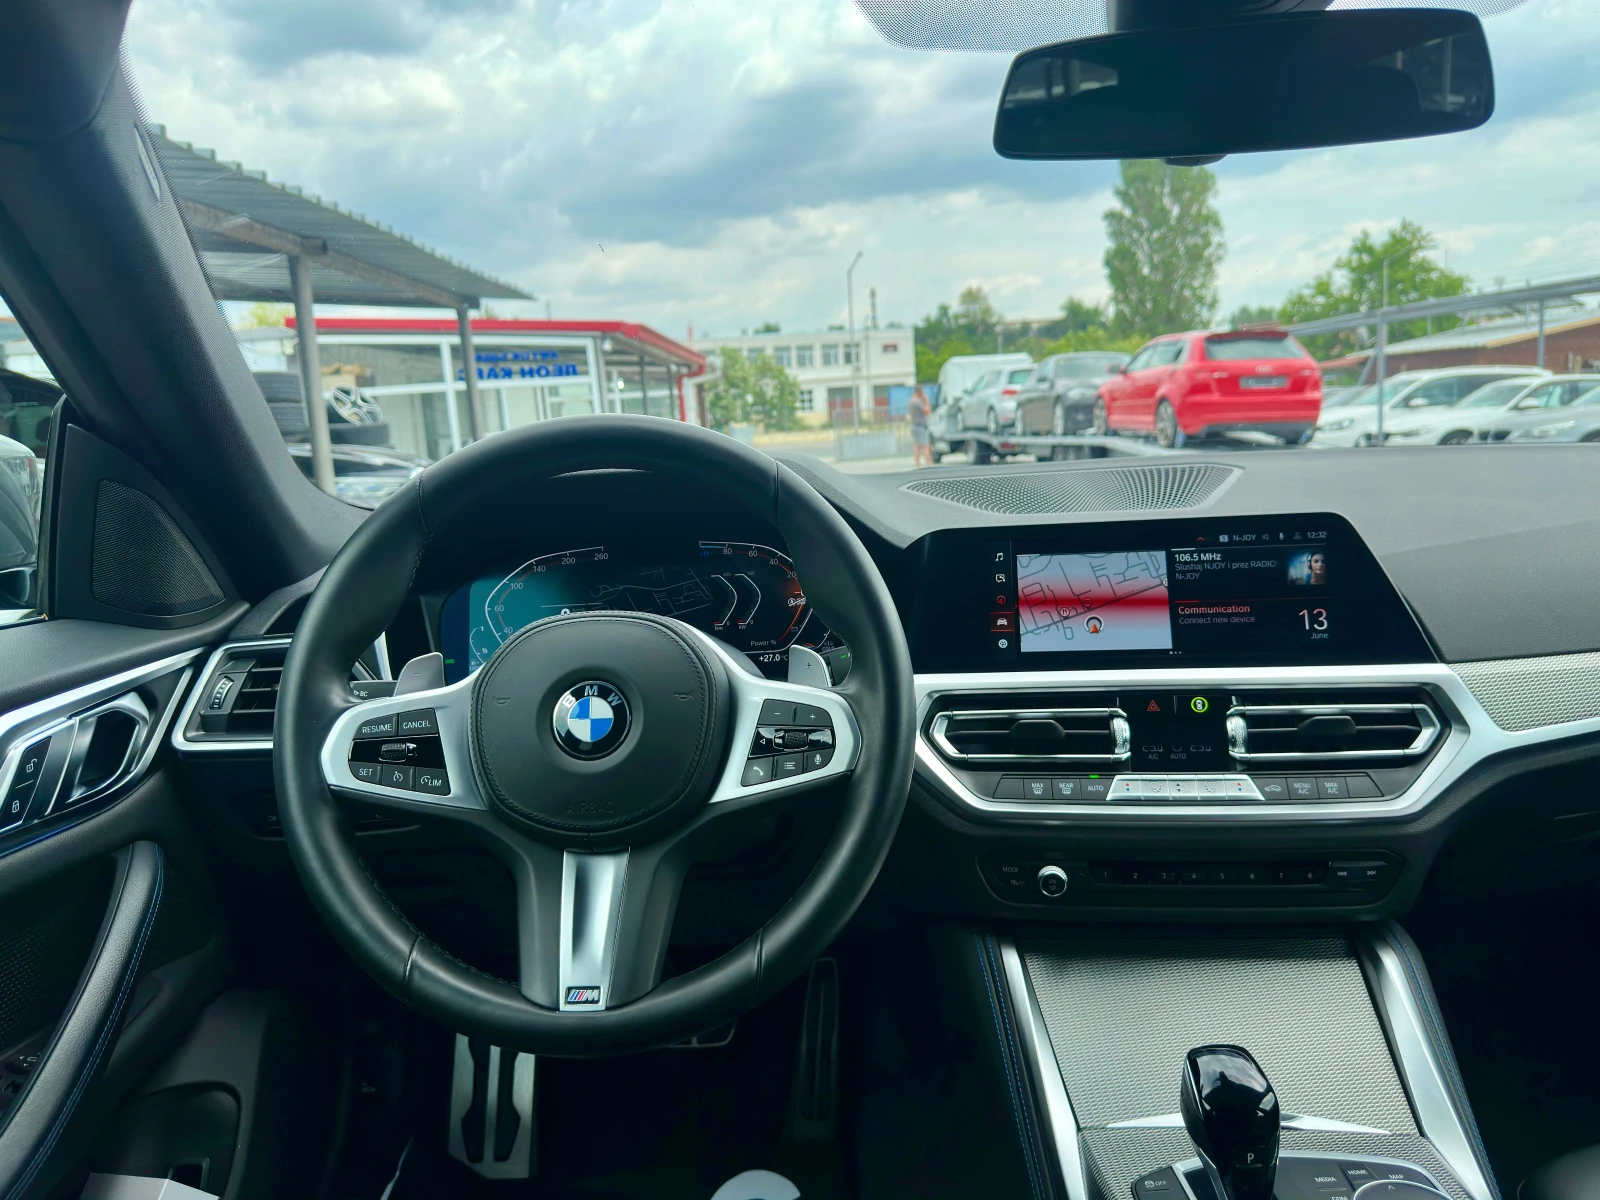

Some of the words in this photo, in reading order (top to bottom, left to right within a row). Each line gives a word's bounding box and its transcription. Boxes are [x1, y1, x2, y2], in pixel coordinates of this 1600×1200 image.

[594, 552, 608, 560] 260
[1174, 554, 1199, 562] 106.5
[1200, 552, 1222, 561] MHz
[561, 557, 576, 565] 200
[1174, 562, 1204, 572] Slushaj
[1232, 562, 1249, 570] prez
[1178, 605, 1250, 614] Communication
[1178, 616, 1211, 624] Connect
[1230, 615, 1255, 623] device
[1298, 608, 1328, 630] 13
[503, 626, 513, 634] 40
[1310, 632, 1328, 640] June
[362, 723, 393, 734] RESUME
[402, 720, 432, 730] CANCEL
[358, 768, 373, 776] SET
[428, 778, 442, 786] LIM
[1247, 1152, 1254, 1164] P
